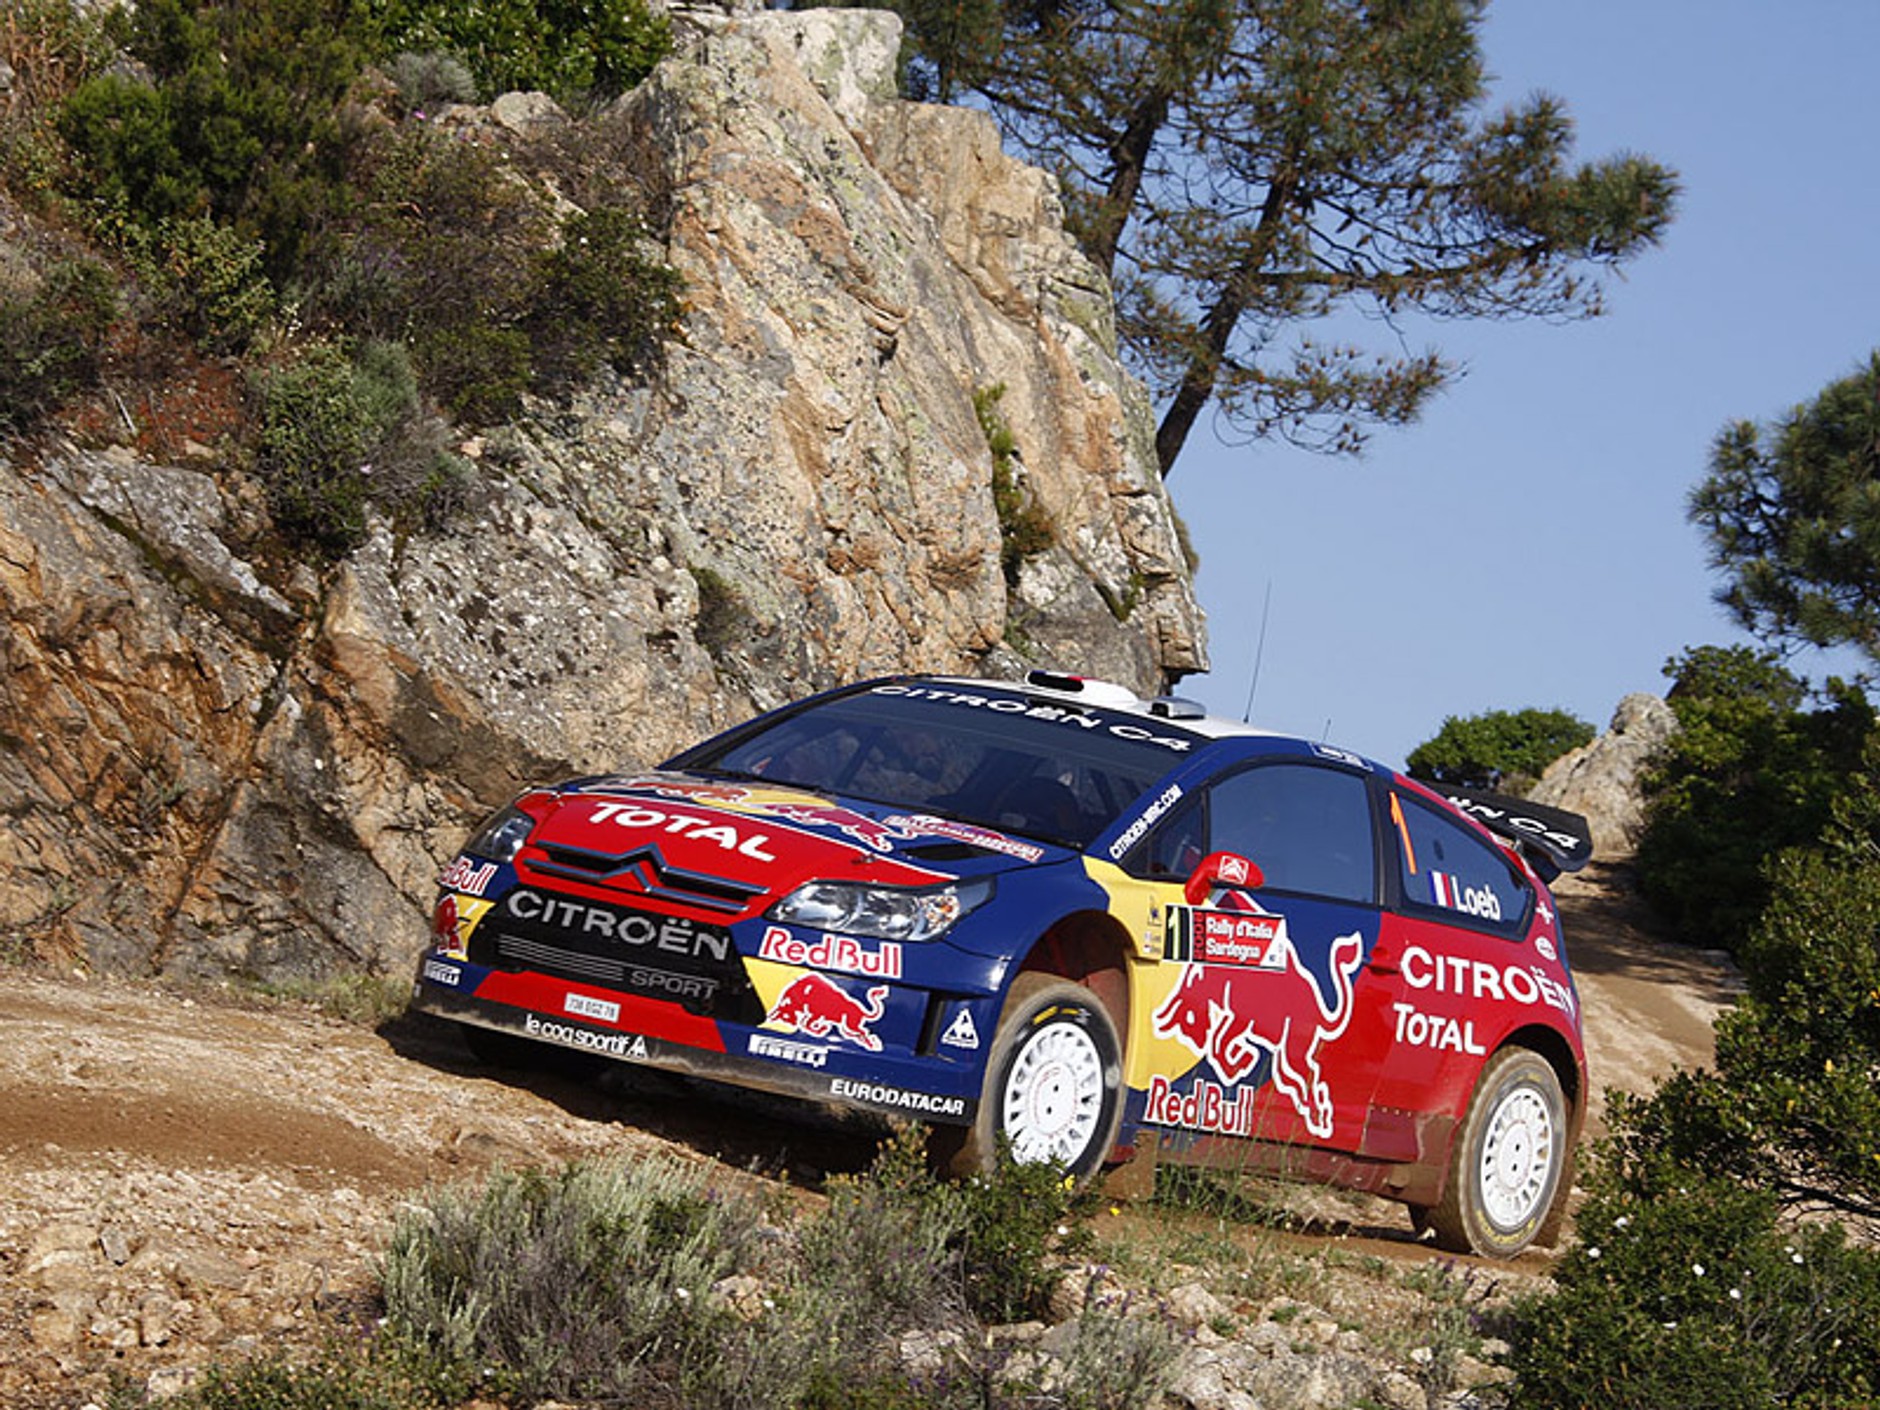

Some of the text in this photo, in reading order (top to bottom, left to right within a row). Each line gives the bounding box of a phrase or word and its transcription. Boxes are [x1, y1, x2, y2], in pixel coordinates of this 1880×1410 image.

[1109, 725, 1191, 752] C4
[589, 802, 776, 863] TOTAL
[1388, 791, 1418, 876] 1
[1509, 817, 1580, 850] C4
[508, 889, 730, 961] CITROËN
[1451, 875, 1501, 922] Loeb
[758, 925, 902, 978] Red Bull
[1168, 906, 1180, 960] 1
[629, 969, 720, 999] SPORT
[1400, 945, 1576, 1020] CITROËN
[525, 1013, 631, 1055] le coq sportif
[1393, 1002, 1487, 1056] TOTAL
[830, 1078, 965, 1116] EURODATACAR
[1144, 1073, 1254, 1136] Red Bull
